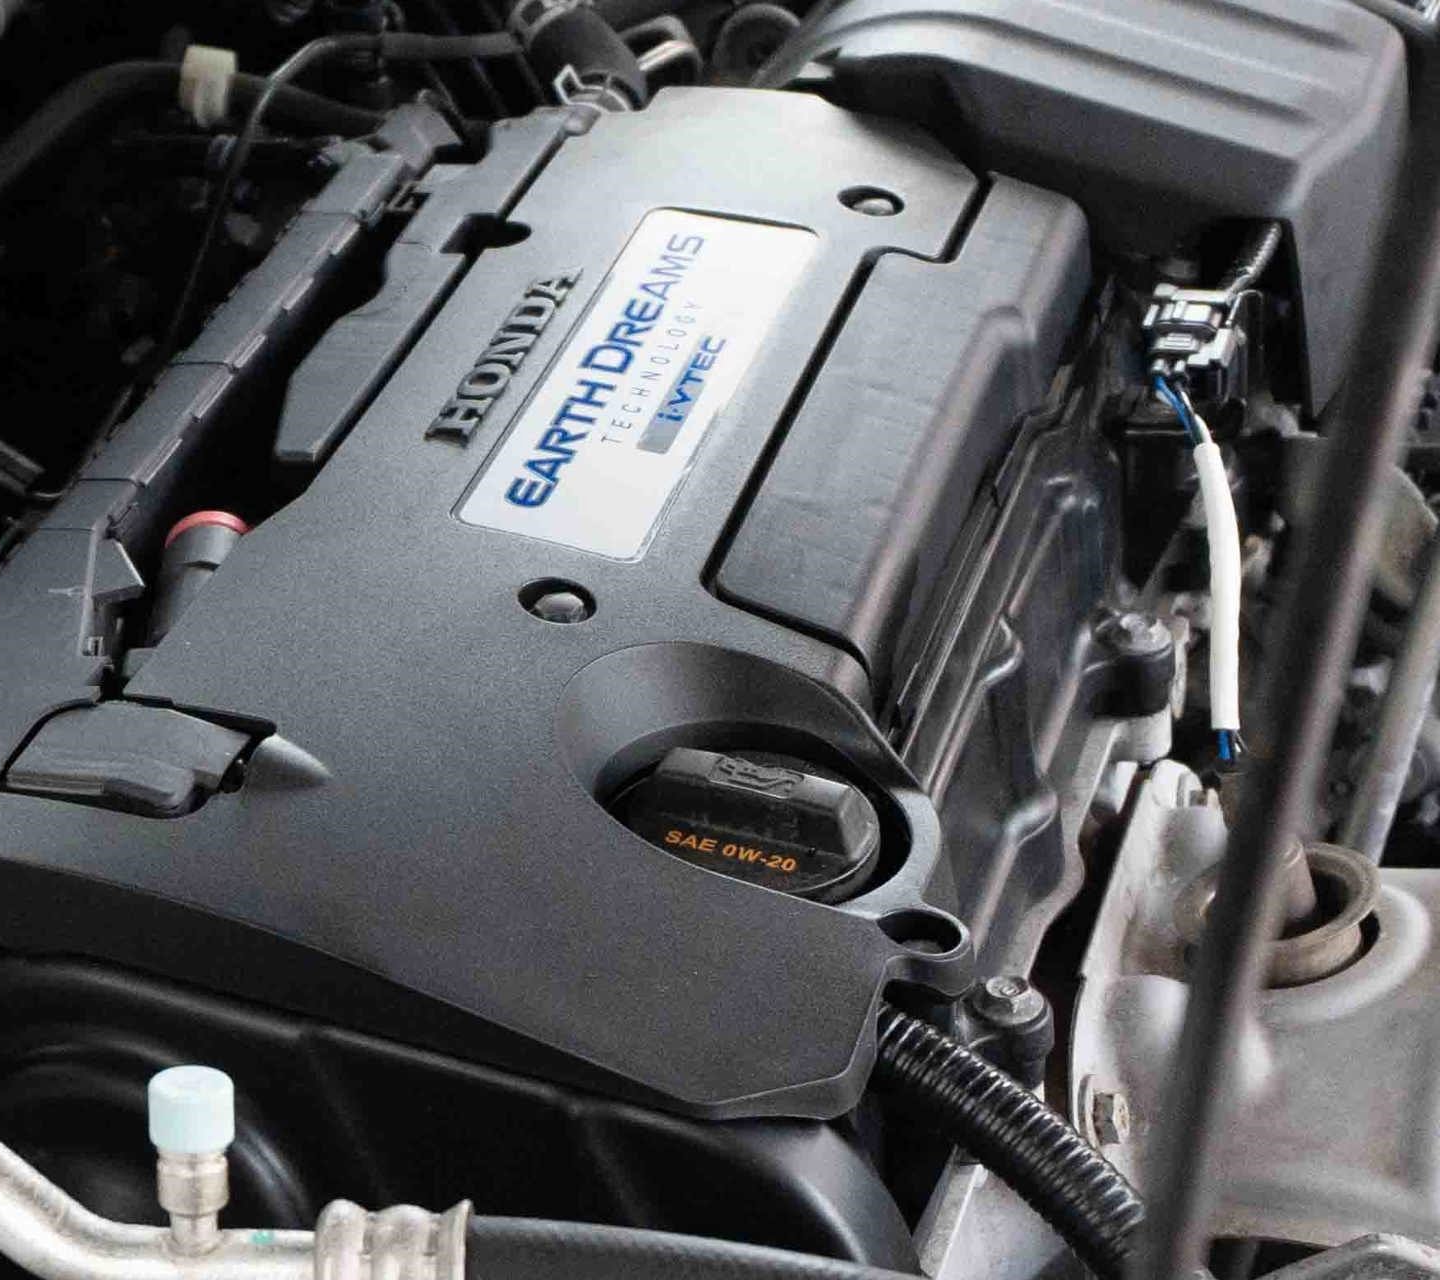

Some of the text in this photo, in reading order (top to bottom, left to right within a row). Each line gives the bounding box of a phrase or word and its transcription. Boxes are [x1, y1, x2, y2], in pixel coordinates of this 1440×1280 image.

[424, 266, 584, 448] HONDA
[504, 231, 706, 509] EARTH DREAMS
[600, 302, 701, 444] TECHNOLOGY
[664, 829, 797, 872] SAE 0W-20
